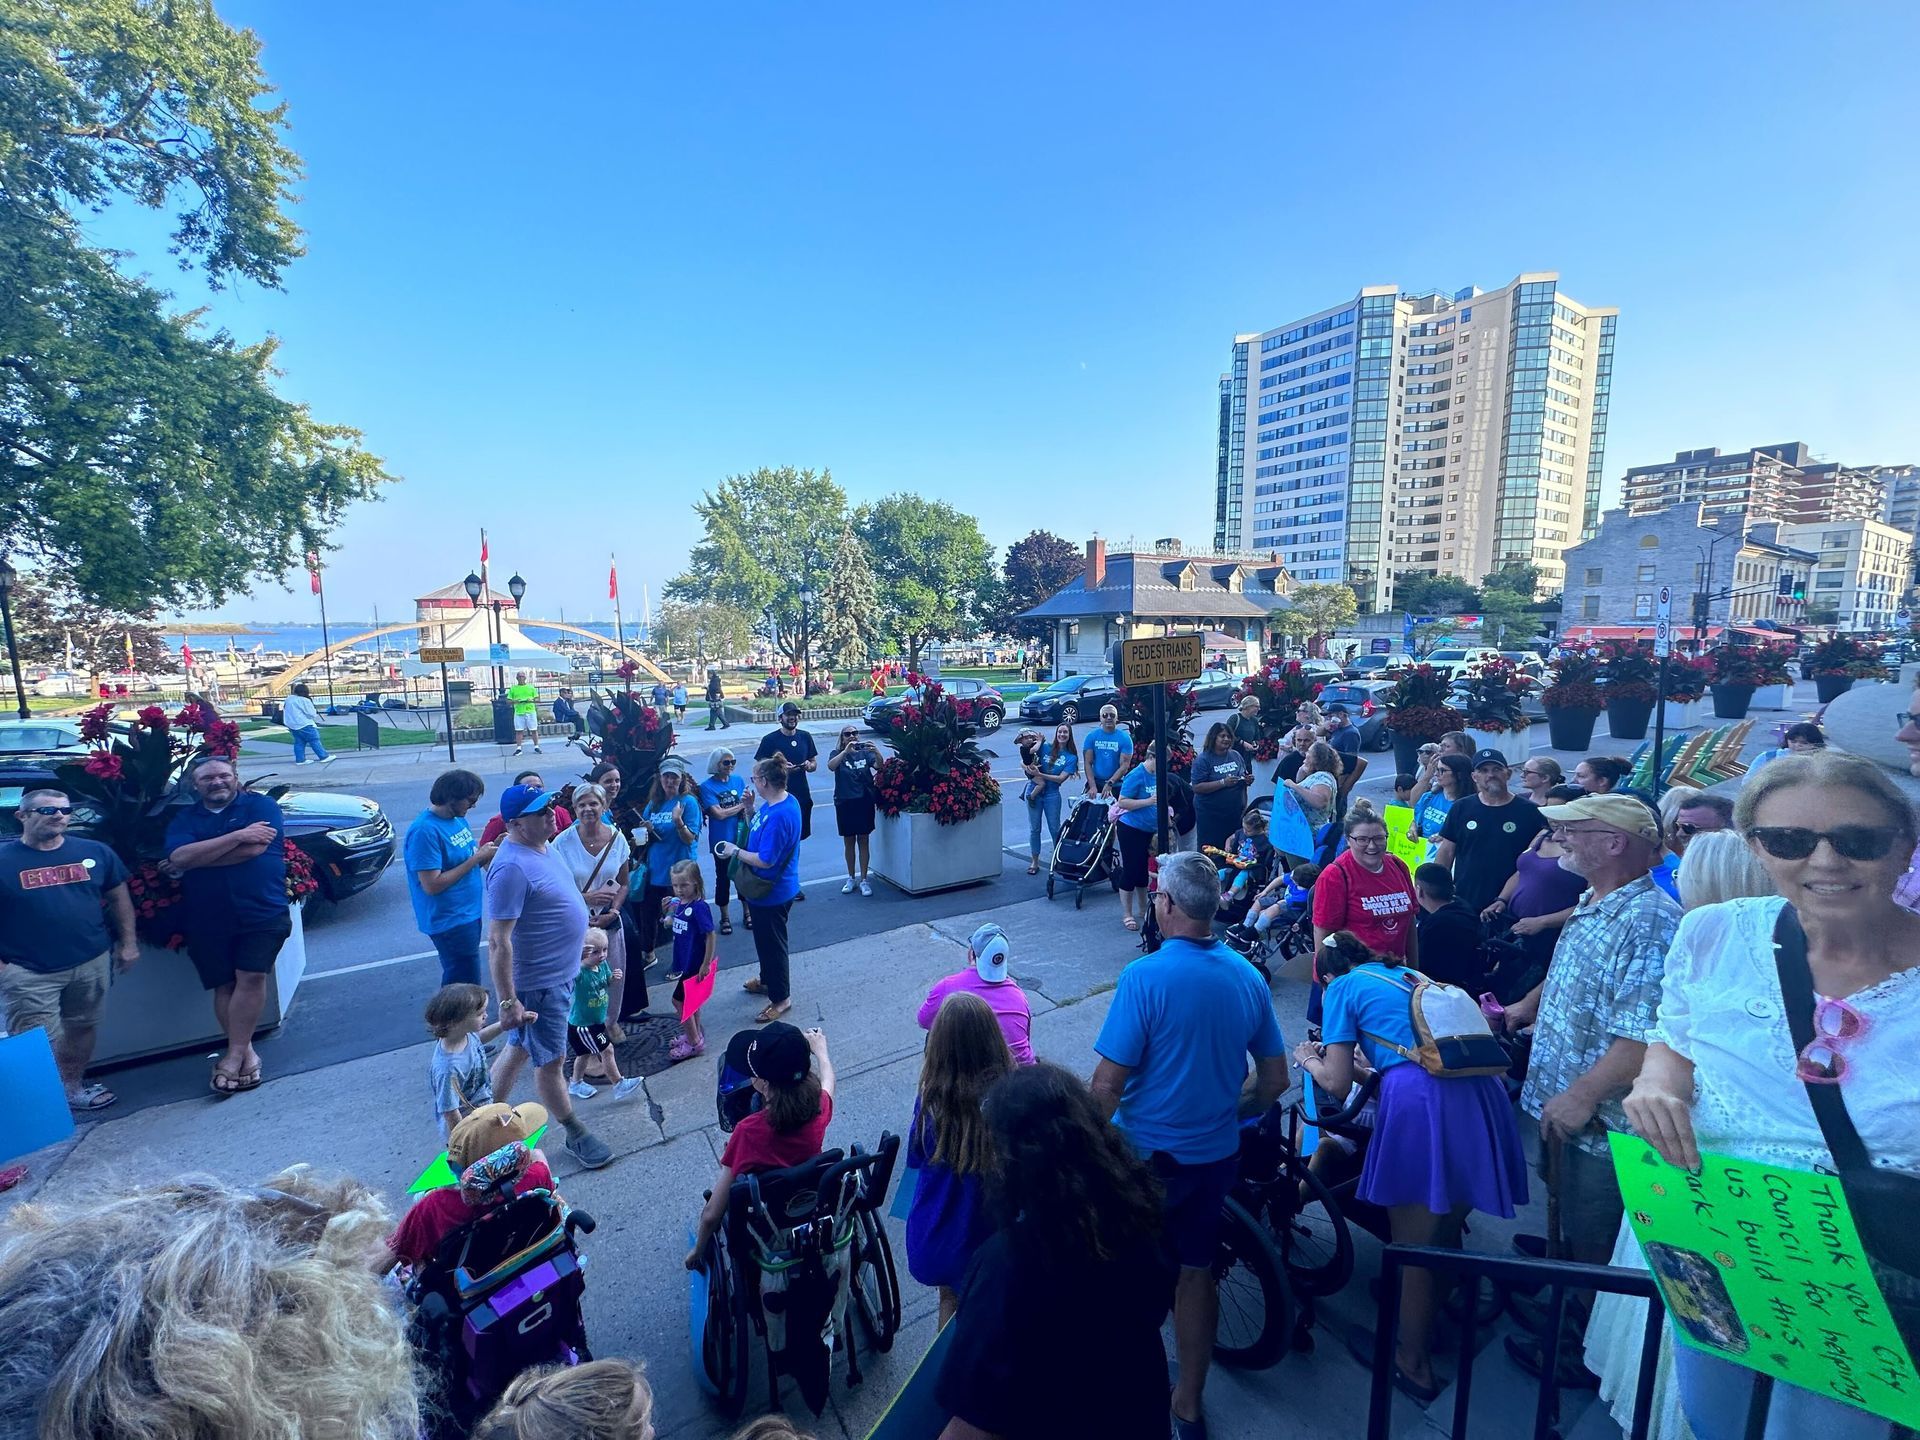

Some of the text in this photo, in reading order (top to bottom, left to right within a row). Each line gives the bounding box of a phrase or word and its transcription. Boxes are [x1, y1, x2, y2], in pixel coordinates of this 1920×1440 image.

[1132, 641, 1193, 662] PEDESTRIANS
[1128, 658, 1198, 681] YIELD TO TRAFFIC
[1362, 901, 1390, 910] SHOULD
[1390, 899, 1400, 907] BE
[1372, 905, 1409, 916] EVERYONE
[1723, 1167, 1805, 1350] us build this
[1762, 1173, 1868, 1404] Council for helping
[1810, 1182, 1856, 1270] Thank
[1866, 1345, 1911, 1394] City
